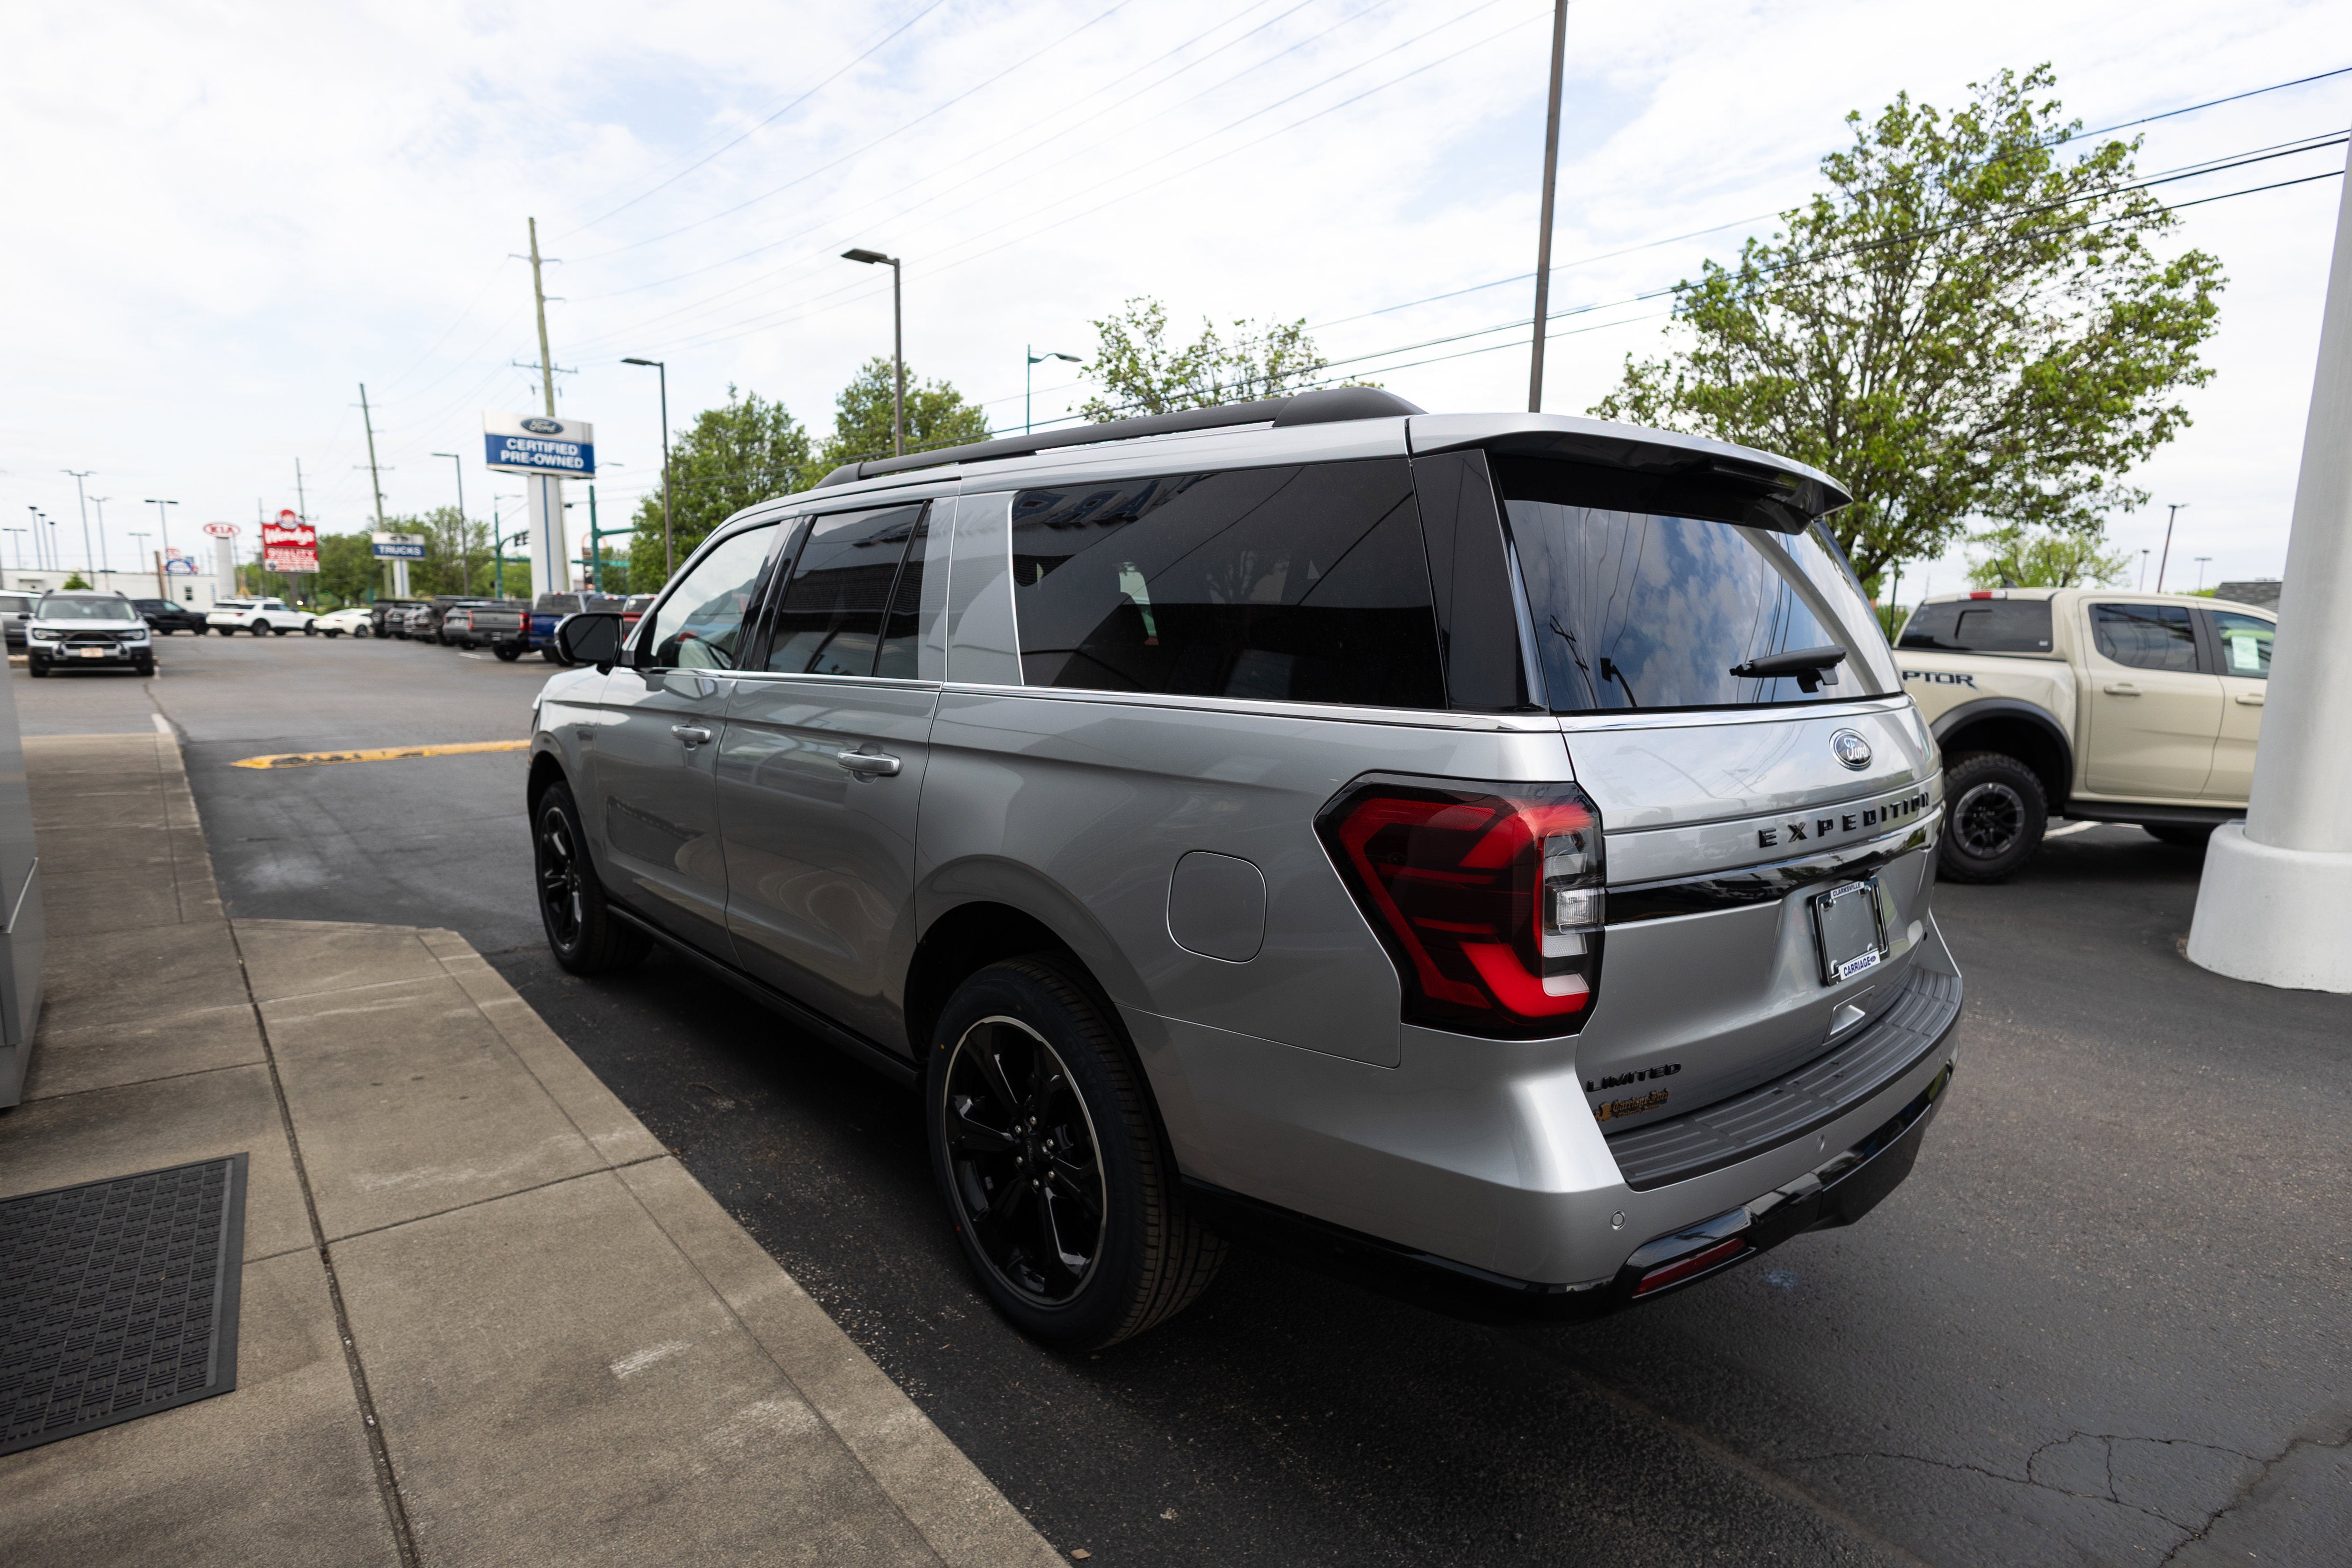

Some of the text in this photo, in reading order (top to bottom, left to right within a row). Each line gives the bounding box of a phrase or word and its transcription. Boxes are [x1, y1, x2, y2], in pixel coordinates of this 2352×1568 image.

[529, 420, 557, 432] Ford
[506, 438, 579, 456] CERTIFIED
[500, 449, 584, 469] PRE-OWNED
[378, 545, 422, 556] TRUCKS
[1901, 669, 1982, 694] PTOR
[1843, 737, 1869, 761] Ford
[1758, 791, 1929, 849] EXPEDITION
[1833, 882, 1862, 897] CLARKSVILLE
[1843, 956, 1871, 977] CARRIAGE
[1586, 1062, 1682, 1093] LIMITED
